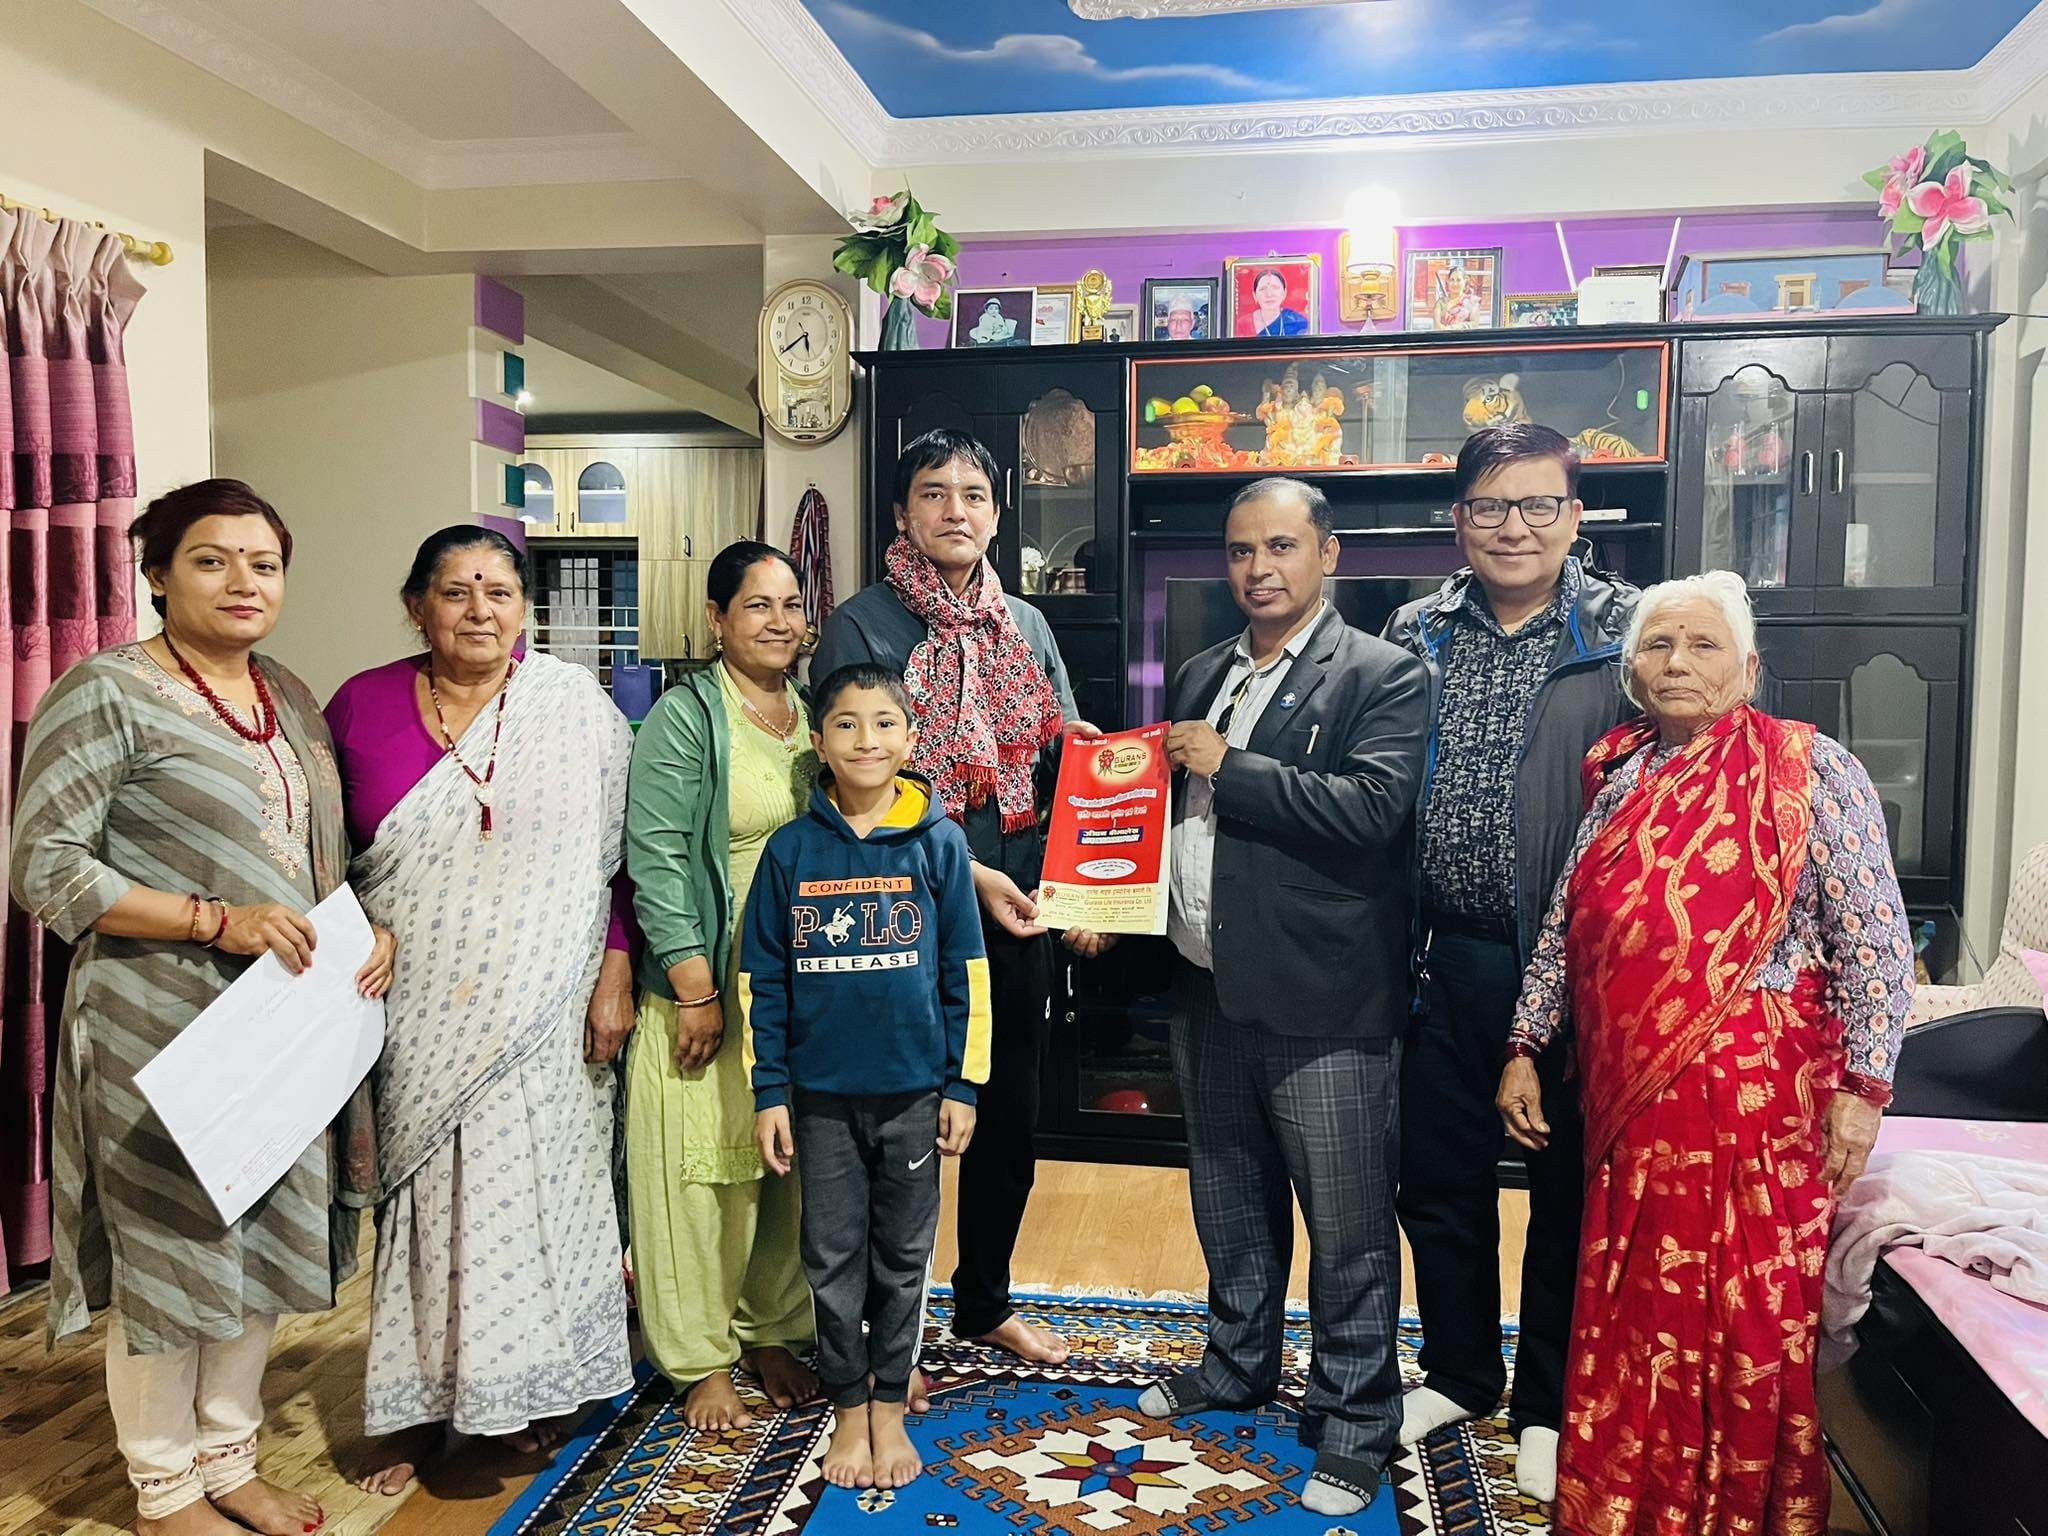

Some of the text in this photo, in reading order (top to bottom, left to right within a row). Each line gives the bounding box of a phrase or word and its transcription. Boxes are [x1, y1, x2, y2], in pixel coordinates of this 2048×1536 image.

[802, 296, 811, 305] 12
[787, 301, 794, 310] 11
[778, 315, 786, 324] 10
[828, 314, 834, 324] 2
[776, 330, 782, 339] 9
[831, 330, 837, 339] 3
[779, 344, 785, 353] 8
[829, 345, 833, 354] 4
[788, 359, 794, 367] 7
[819, 359, 825, 367] 5
[803, 364, 809, 373] 6
[1114, 752, 1147, 764] GURANS
[808, 880, 904, 893] CONFIDENT
[800, 951, 917, 971] RELEASE
[1312, 1471, 1372, 1504] rekking
